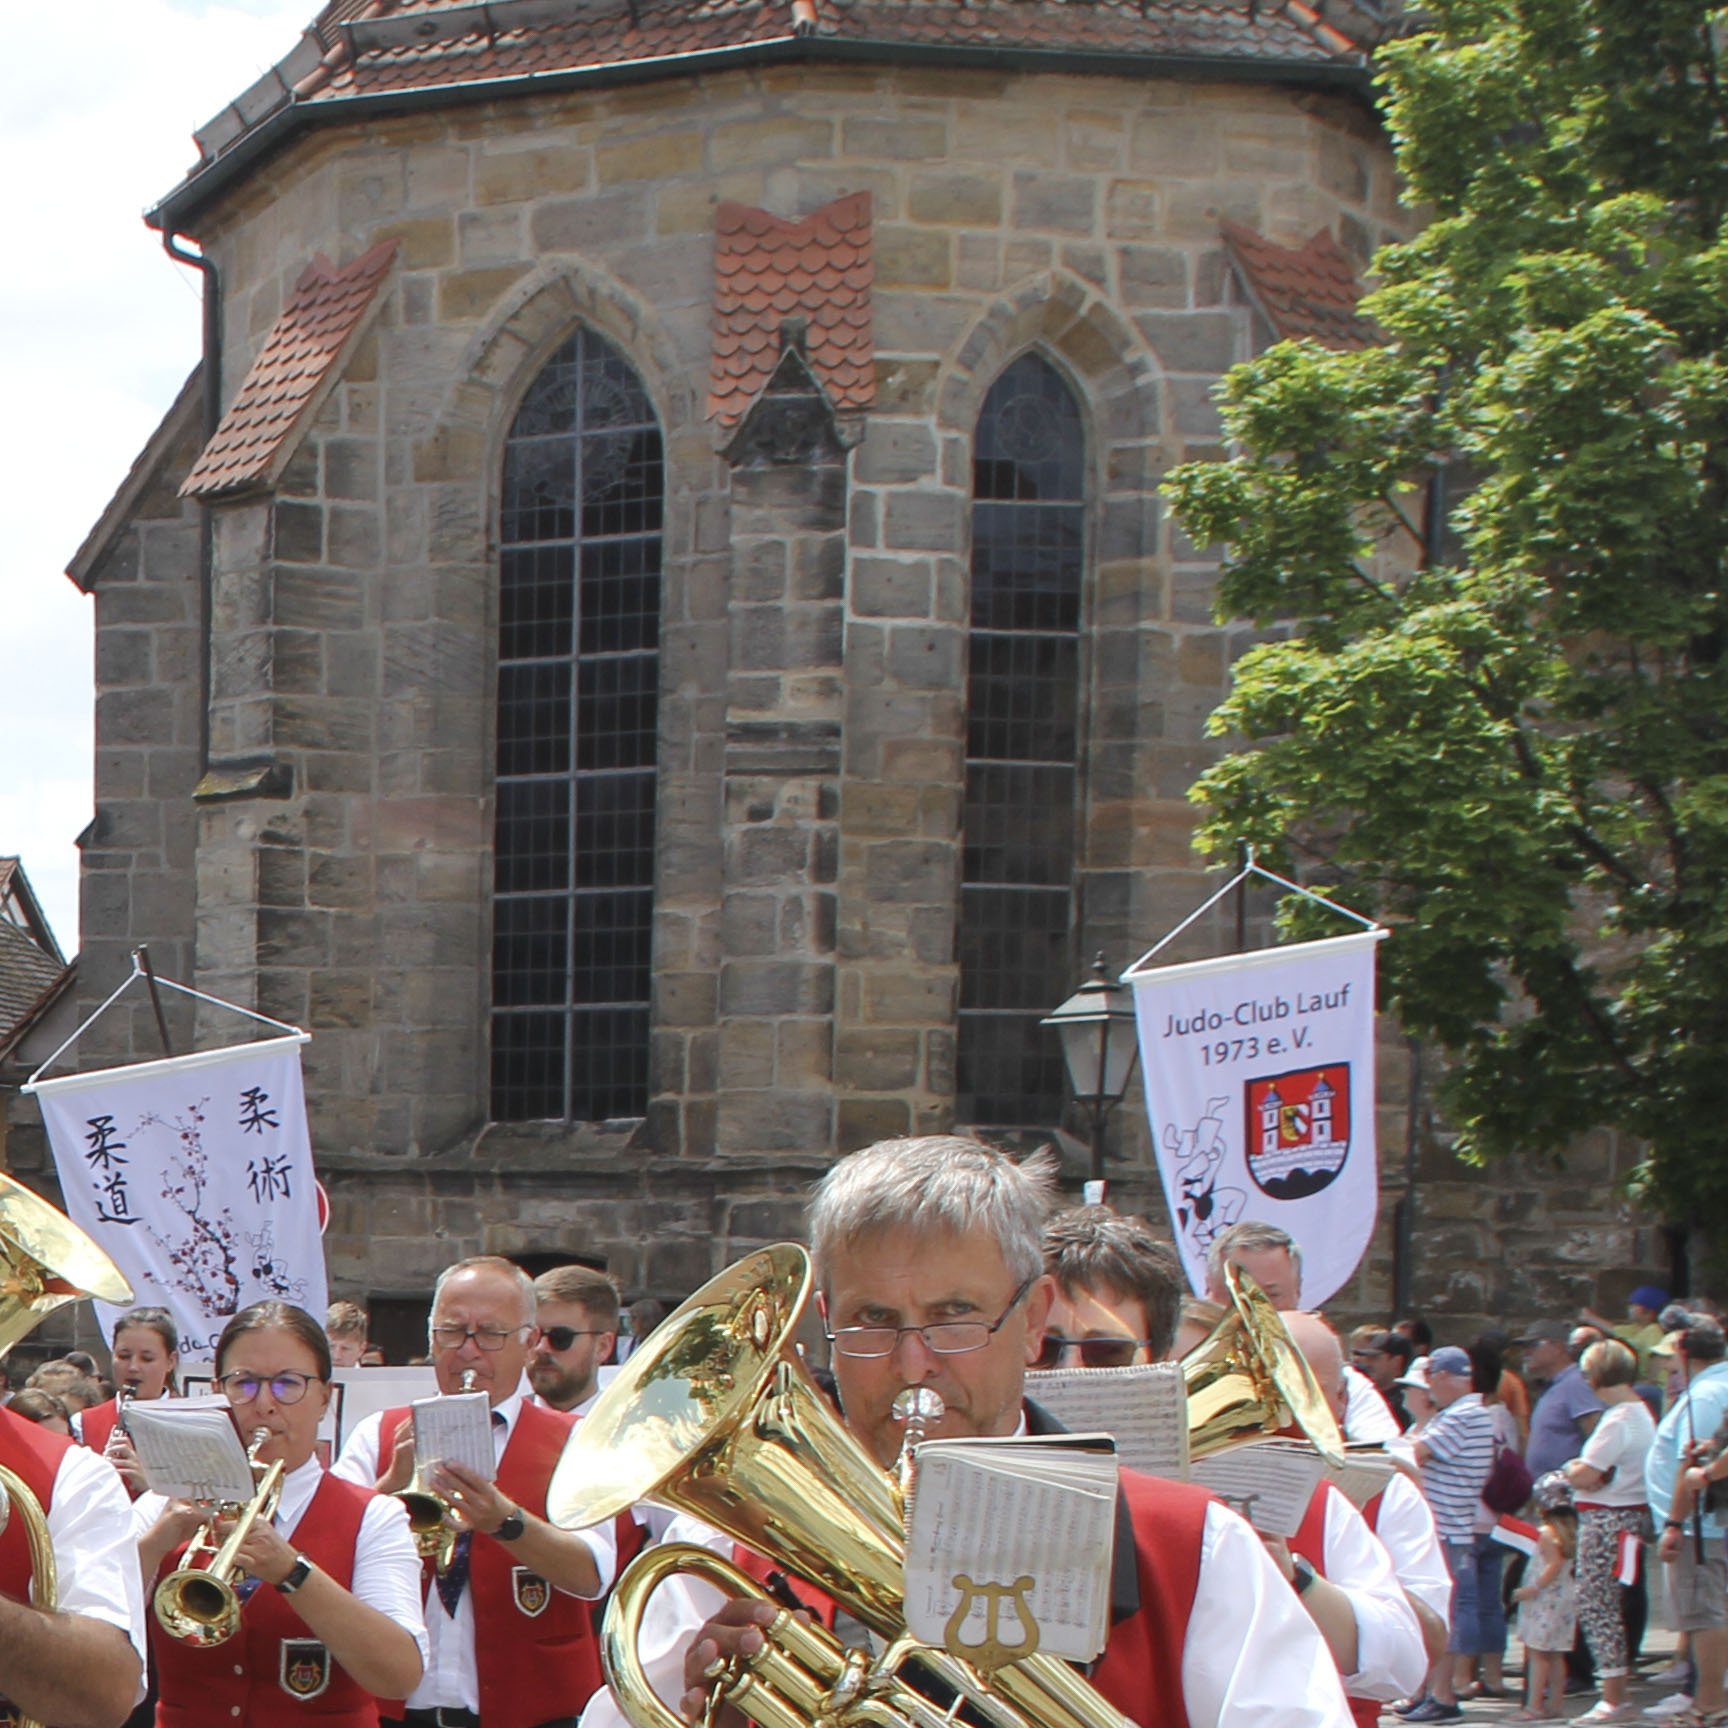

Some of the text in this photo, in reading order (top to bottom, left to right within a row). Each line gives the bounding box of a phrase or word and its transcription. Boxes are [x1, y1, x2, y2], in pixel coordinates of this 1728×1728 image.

[1162, 982, 1351, 1038] Judo-Club Lauf
[1201, 1025, 1314, 1066] 1973 e. V.
[84, 1114, 145, 1225] 柔道
[238, 1085, 294, 1205] 柔術
